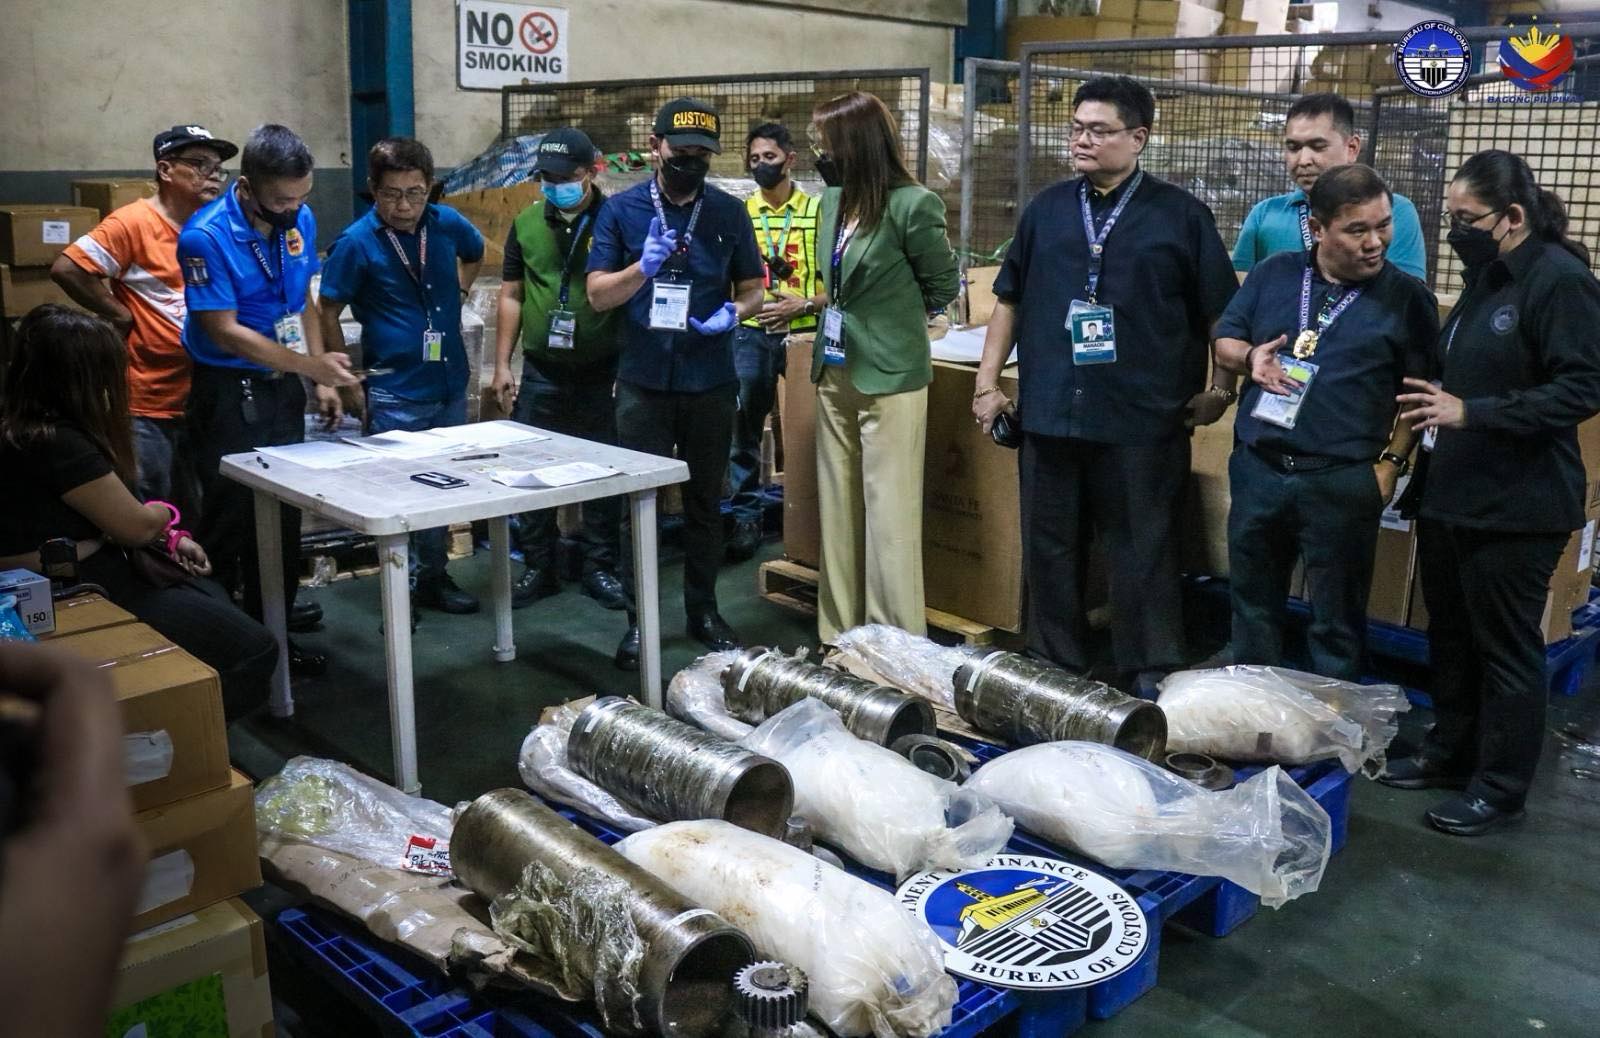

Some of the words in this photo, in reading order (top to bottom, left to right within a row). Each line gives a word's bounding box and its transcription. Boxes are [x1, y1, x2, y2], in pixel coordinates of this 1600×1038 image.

[466, 10, 514, 46] NO
[465, 51, 562, 74] SMOKING
[673, 111, 717, 130] CUSTOMS
[26, 612, 46, 624] 150
[970, 961, 1080, 983] BUREAU
[1088, 956, 1117, 974] OF
[1107, 892, 1141, 956] CUSTOMS
